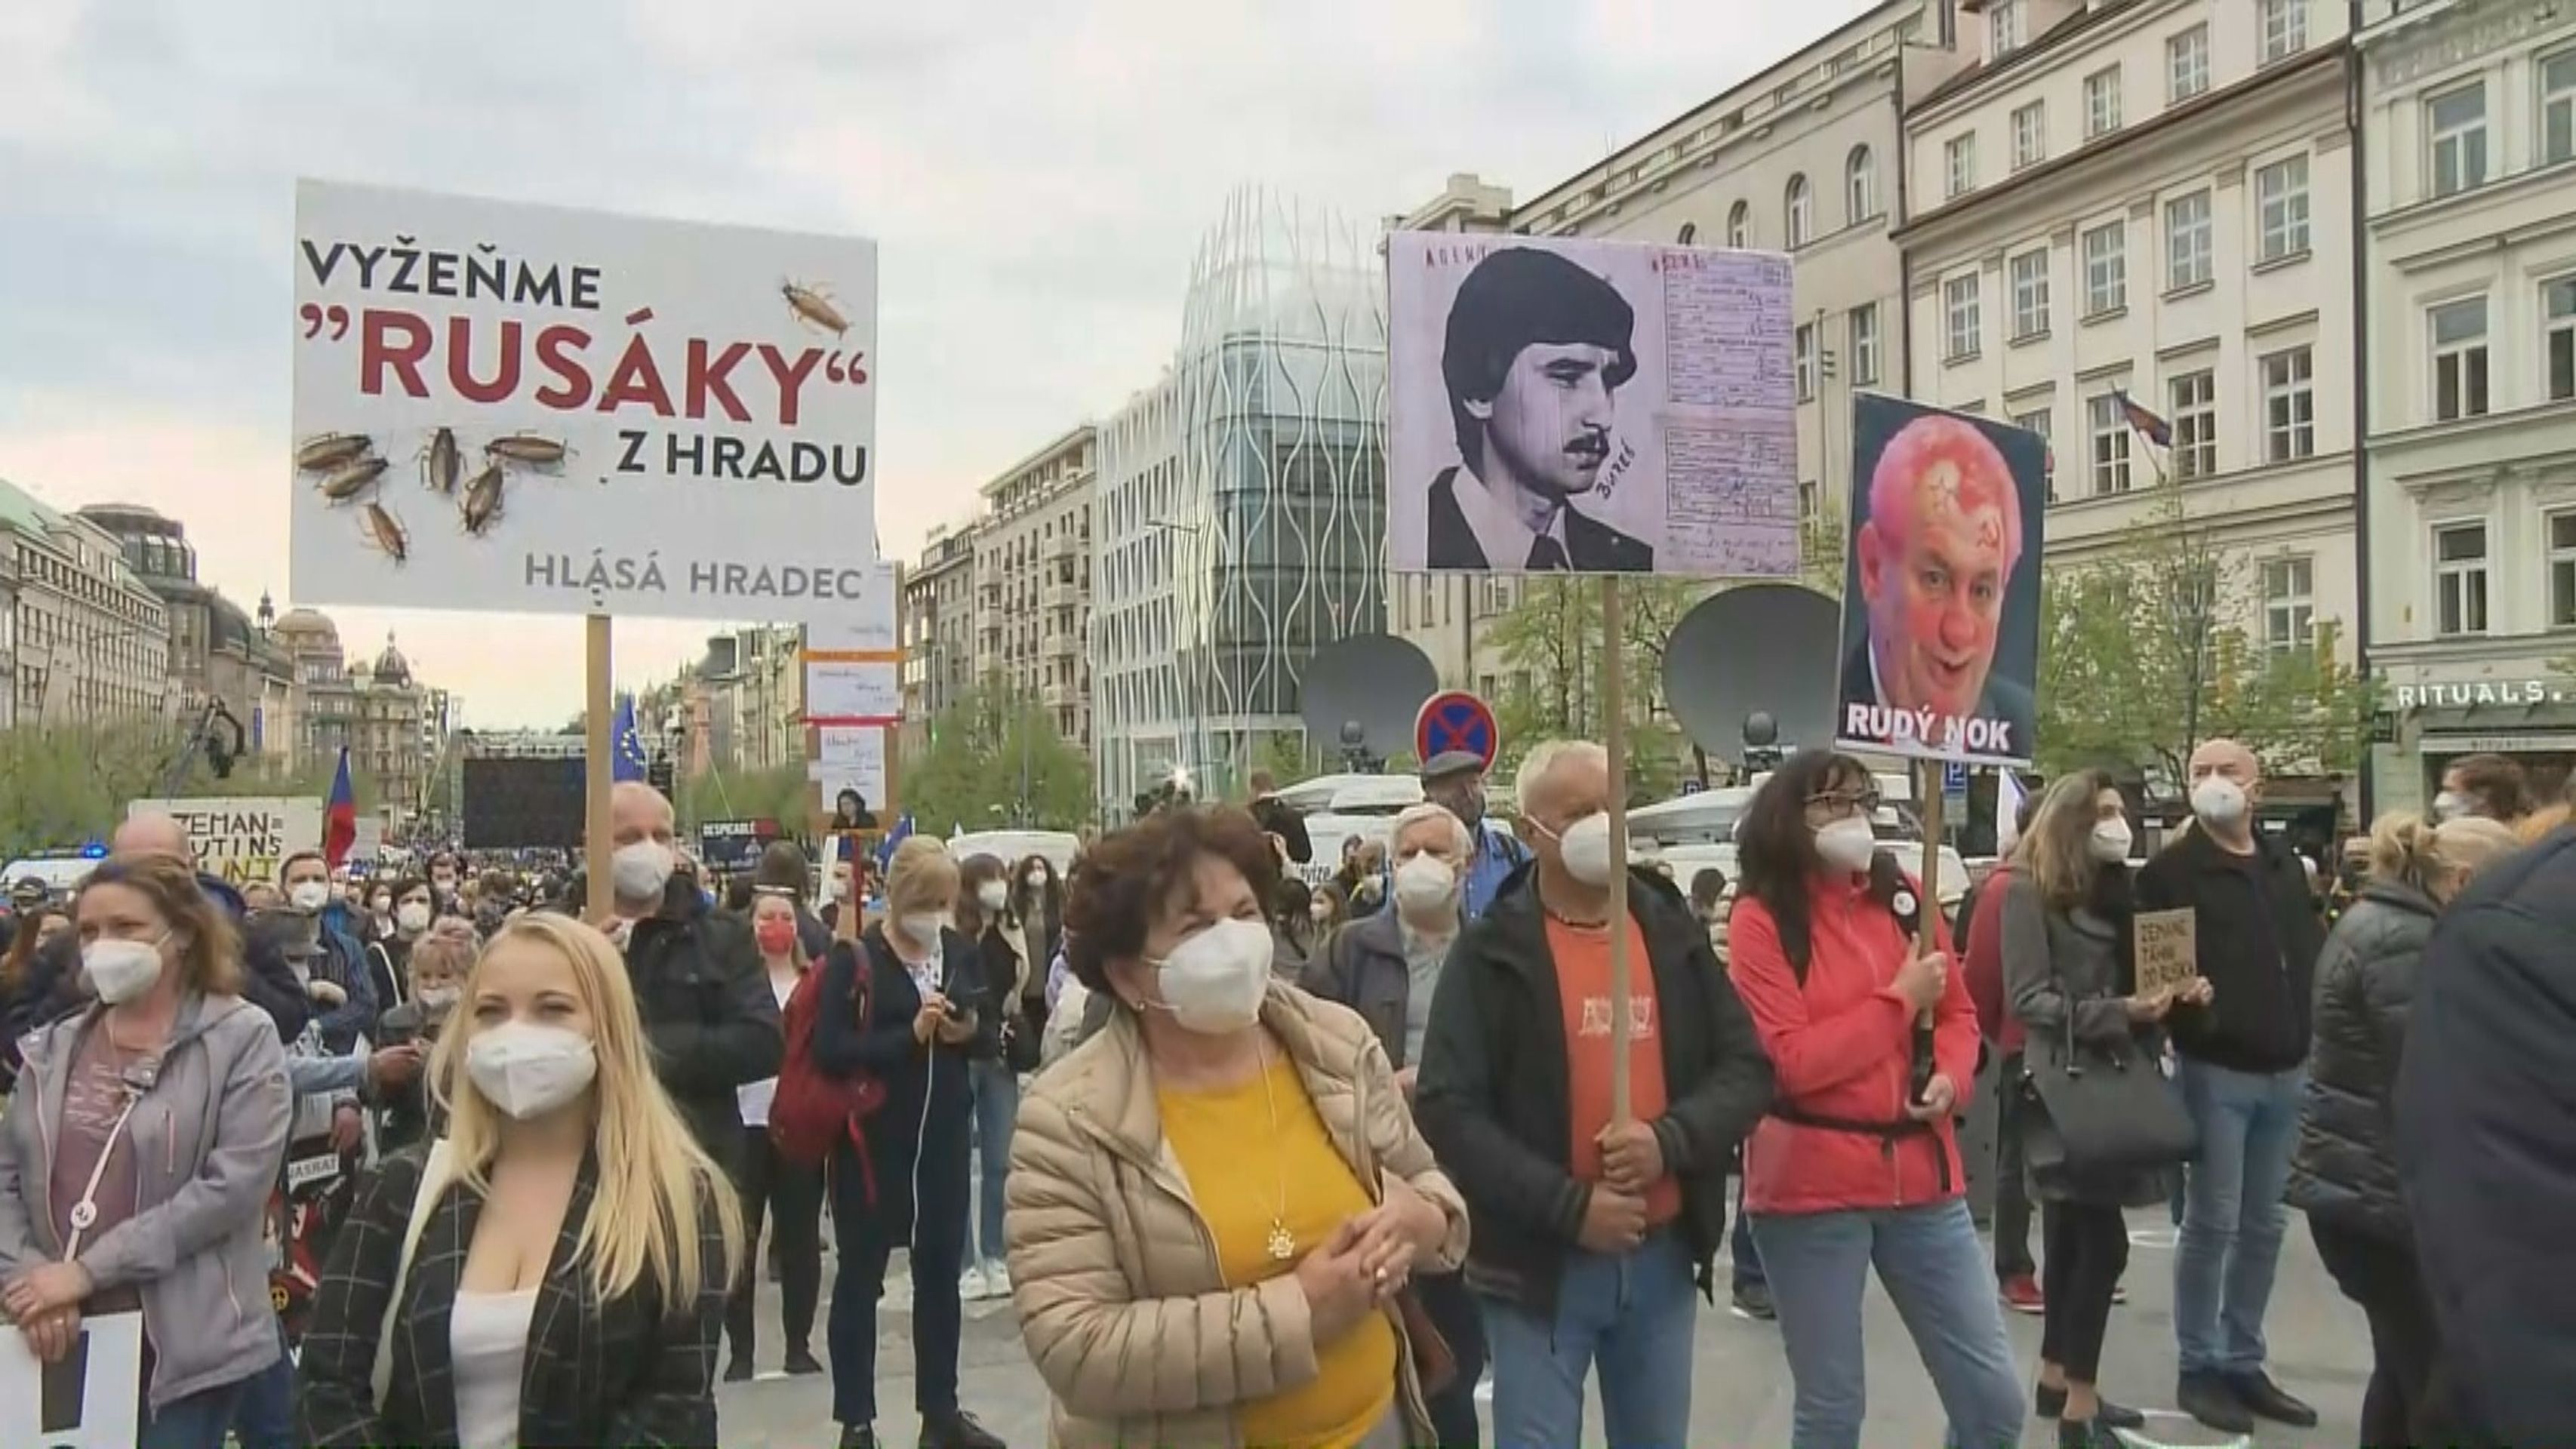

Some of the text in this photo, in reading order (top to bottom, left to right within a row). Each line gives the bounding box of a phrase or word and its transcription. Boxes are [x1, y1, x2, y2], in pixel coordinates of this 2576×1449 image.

[302, 235, 601, 310] VYŽEŇME
[617, 431, 866, 486] Z HRADU
[525, 548, 862, 600] HLÁSÁ HRADEC
[1846, 703, 2011, 752] RUDÝ NOK
[189, 832, 282, 857] UTIN'S
